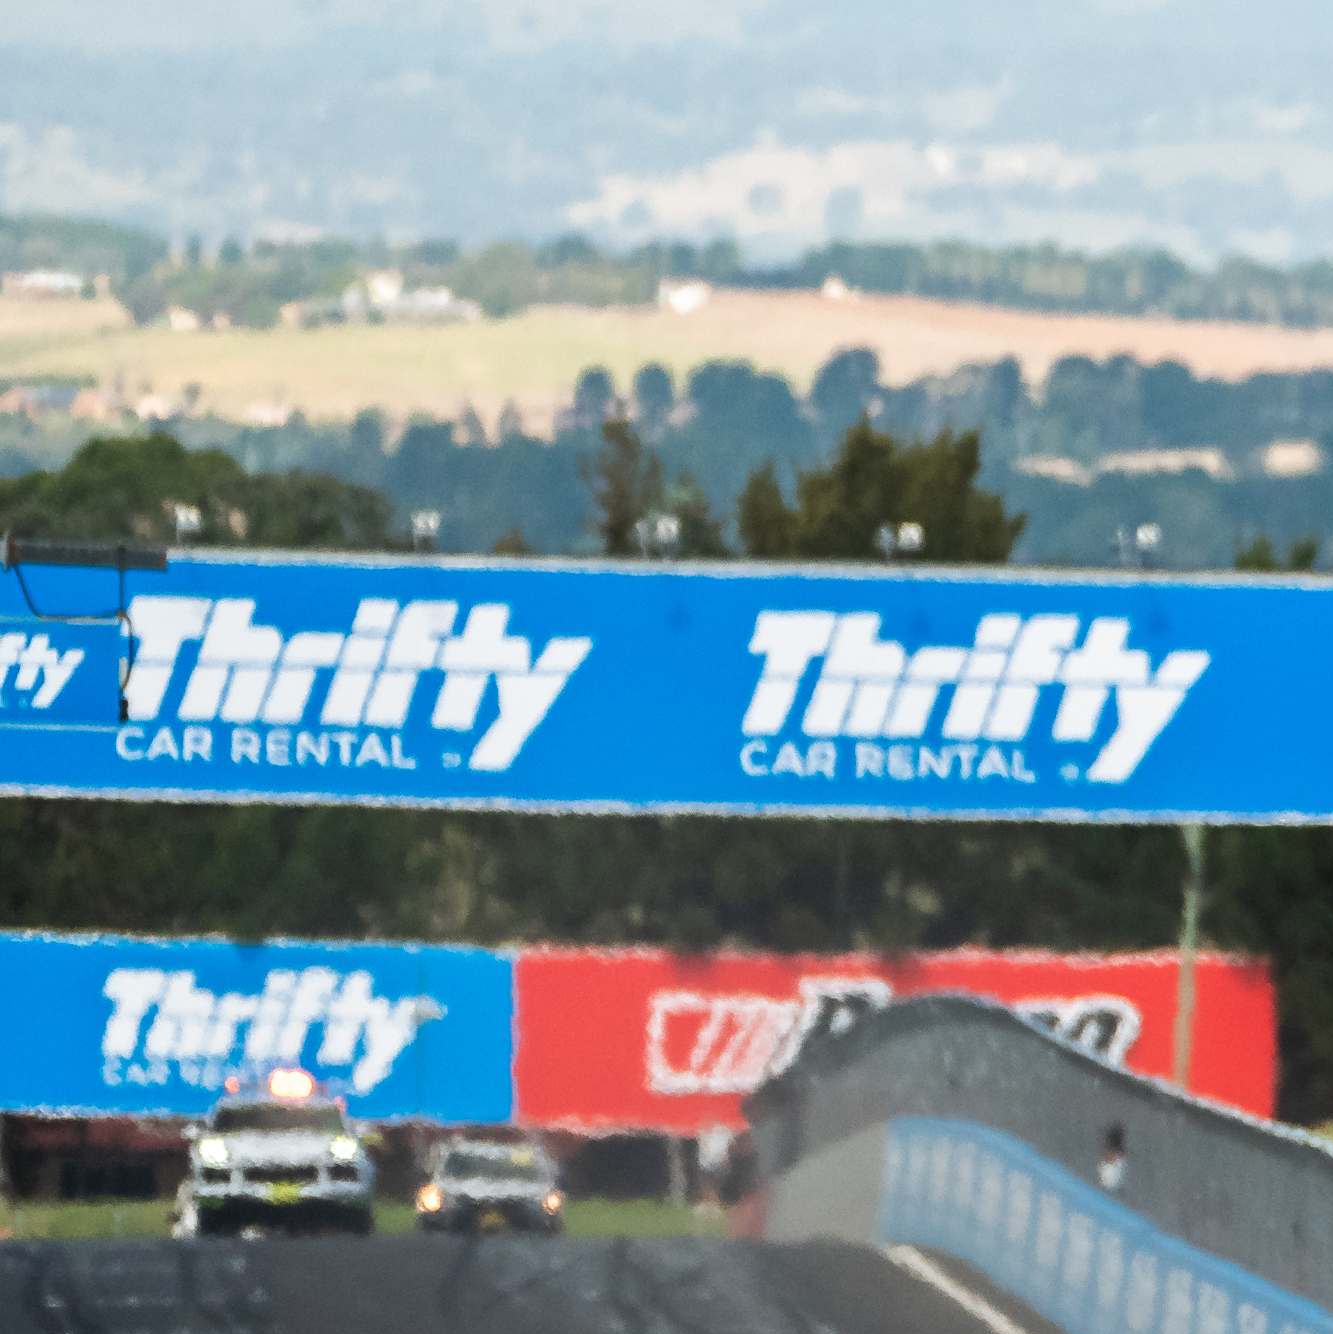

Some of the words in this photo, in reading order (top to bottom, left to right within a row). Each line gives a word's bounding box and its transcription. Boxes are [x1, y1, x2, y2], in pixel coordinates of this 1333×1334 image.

[125, 596, 592, 771] Thrifty
[742, 611, 1211, 784] Thrifty
[116, 727, 212, 761] CAR
[230, 729, 416, 770] RENTAL
[741, 741, 836, 777] CAR
[855, 744, 1036, 783] RENTAL
[103, 968, 447, 1095] Thrifty
